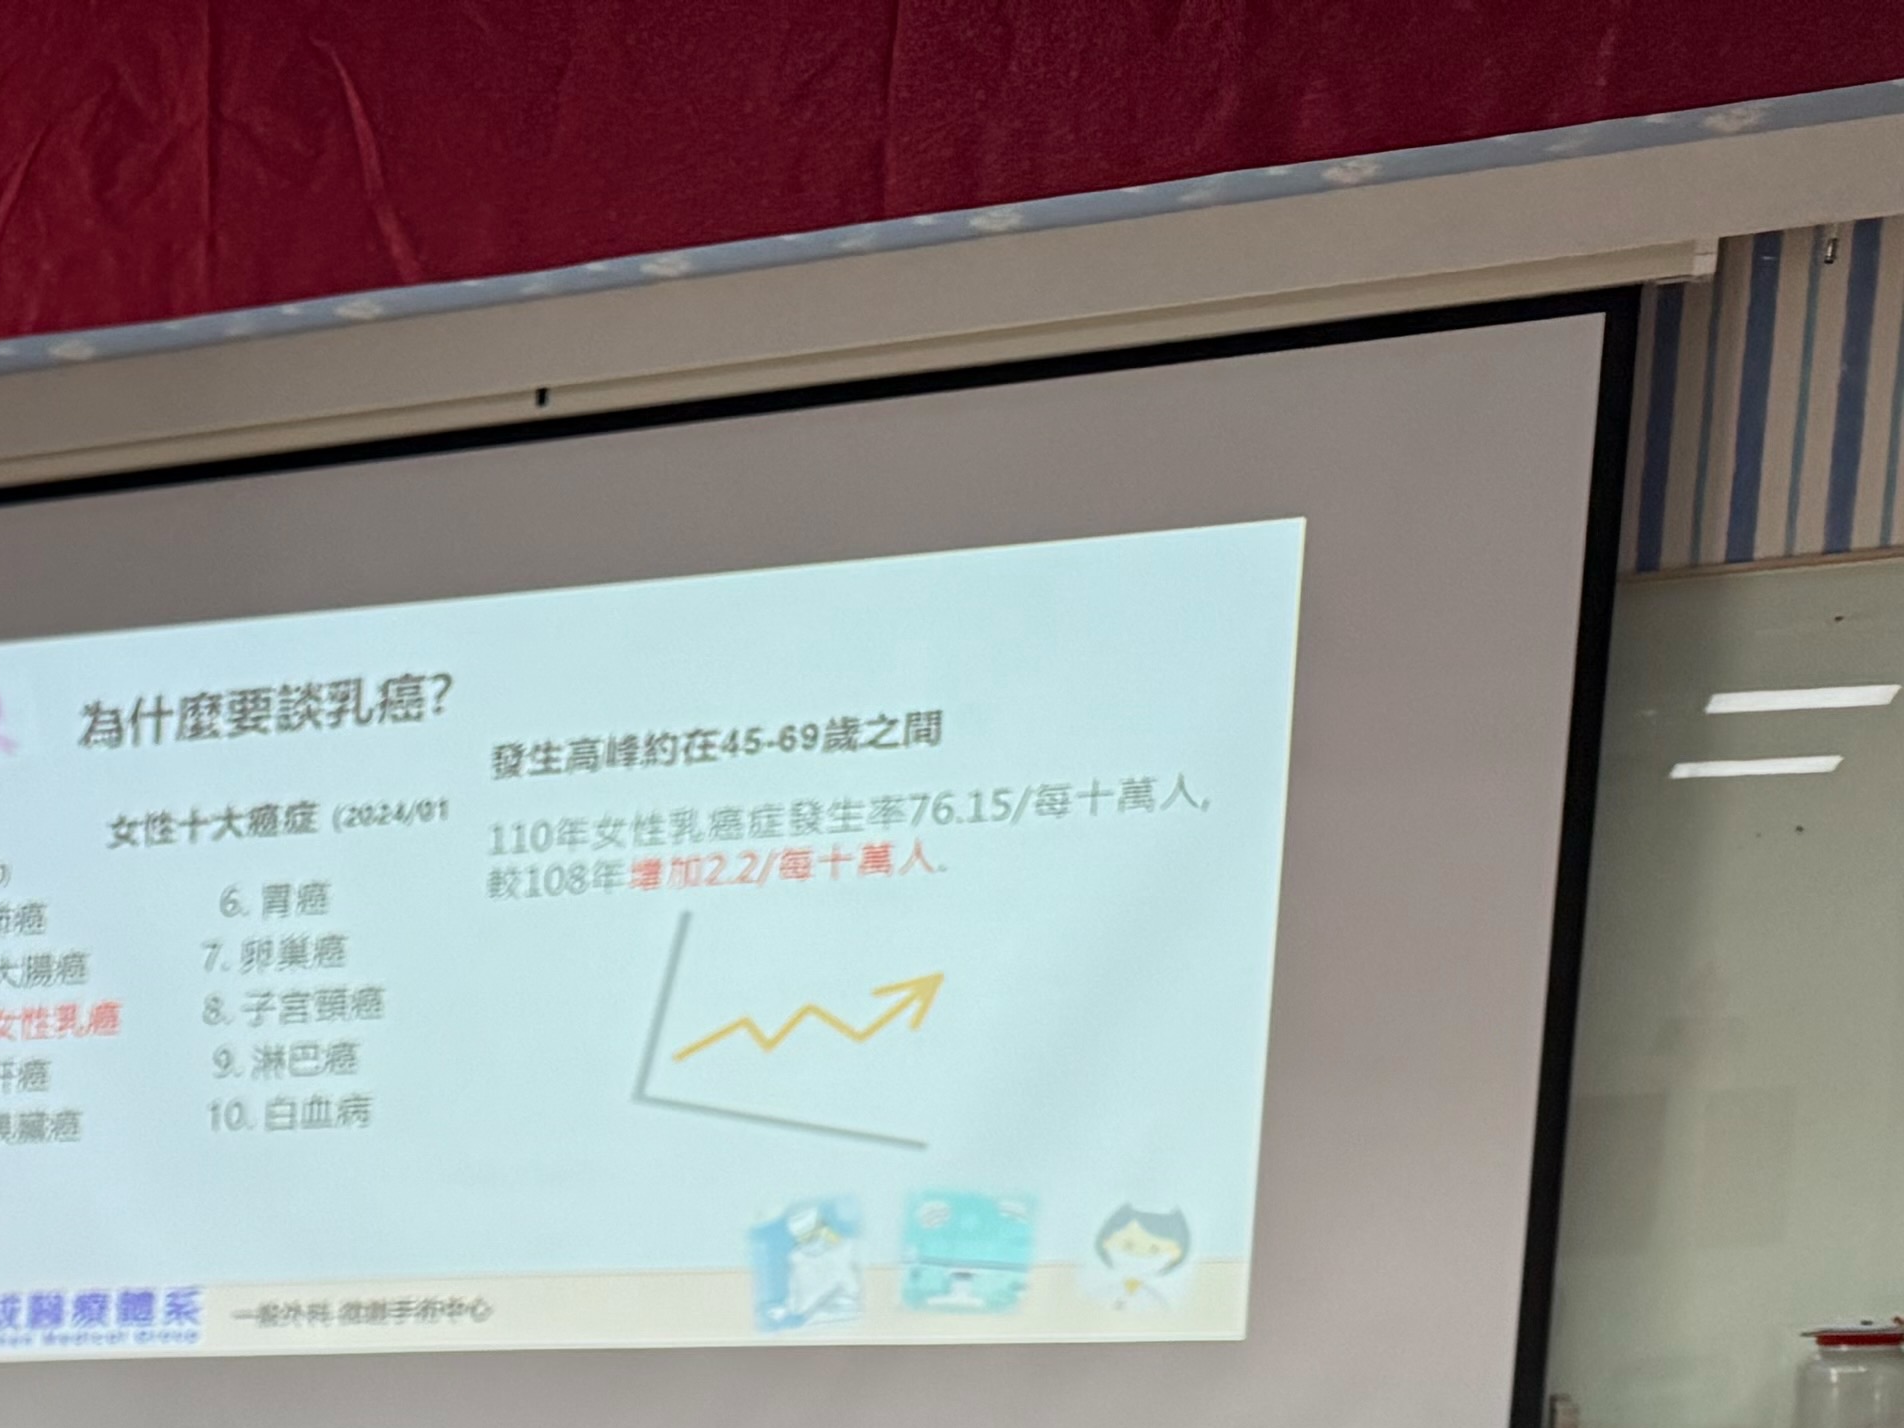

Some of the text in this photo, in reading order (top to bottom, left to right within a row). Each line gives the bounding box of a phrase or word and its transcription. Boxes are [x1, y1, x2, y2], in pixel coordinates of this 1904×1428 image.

[78, 673, 454, 749] 為什麼要談乳癌?
[491, 709, 943, 780] 發生高峰約在45-69歲之間
[107, 801, 320, 849] 女性十大癌症
[261, 880, 332, 921] 胃癌
[239, 932, 349, 975] 卵巢癌
[251, 1041, 361, 1080] 淋巴癌
[265, 1092, 372, 1133] 白血病
